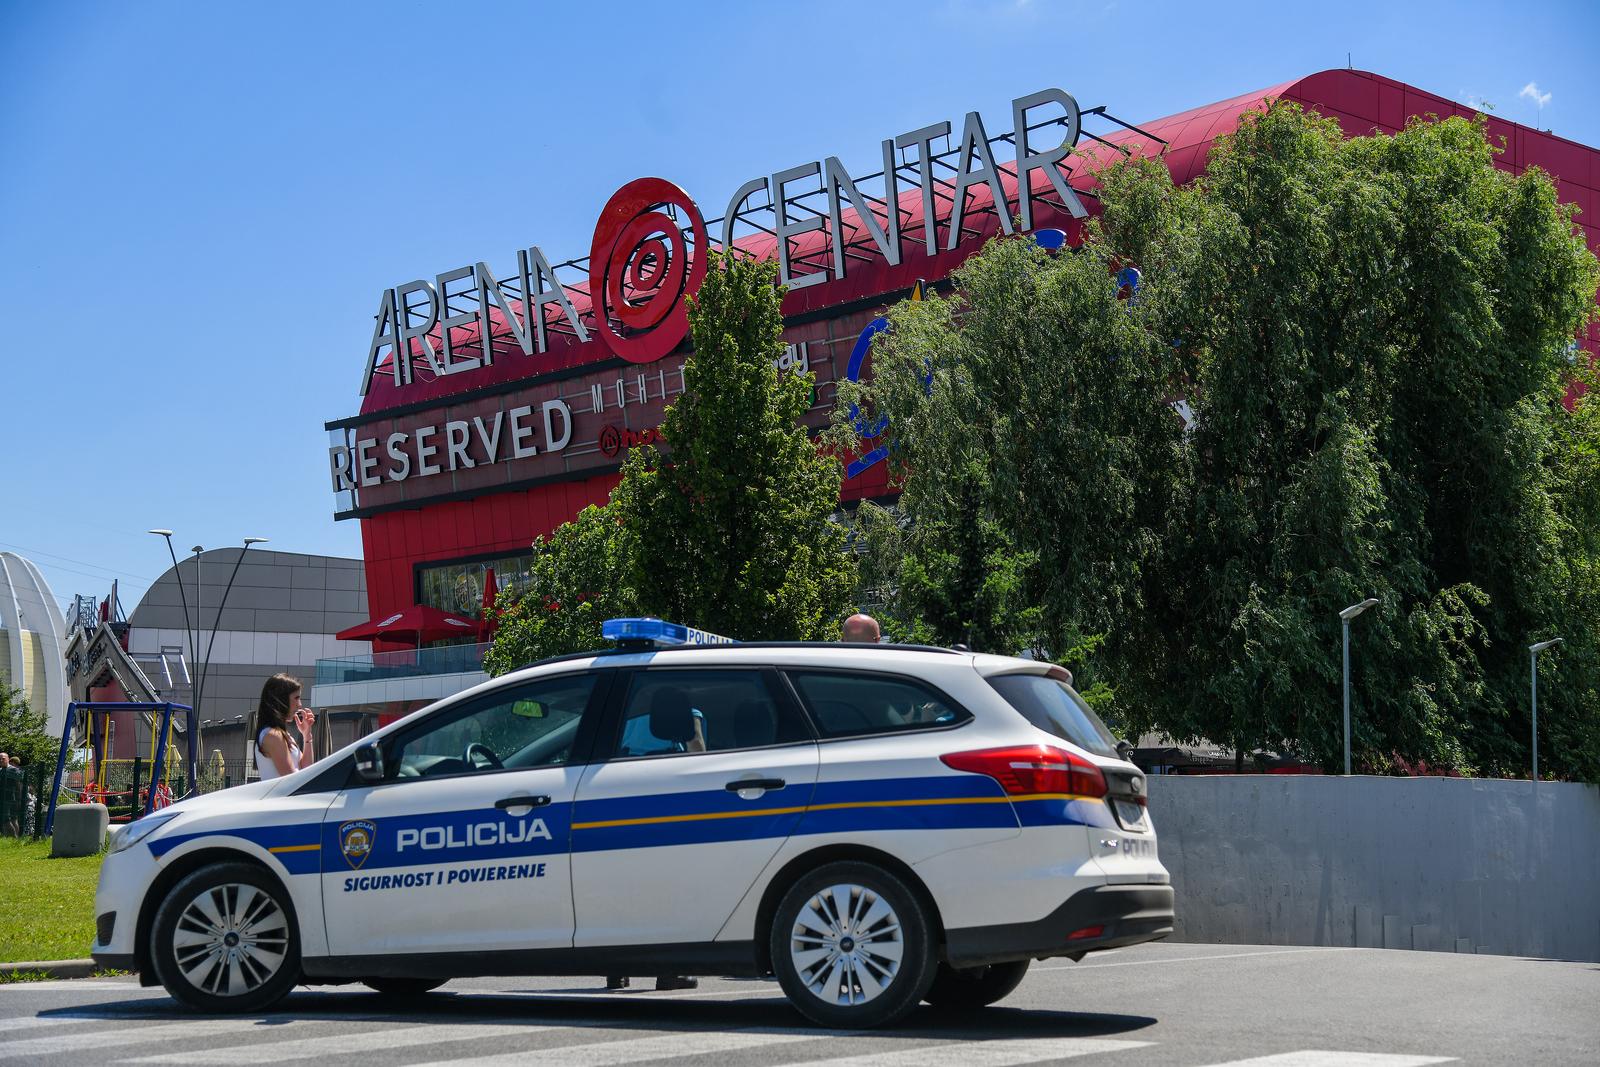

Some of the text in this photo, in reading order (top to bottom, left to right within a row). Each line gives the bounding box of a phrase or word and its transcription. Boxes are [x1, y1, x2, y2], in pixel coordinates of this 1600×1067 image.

[359, 87, 1089, 397] ARENA CENTAR
[591, 364, 687, 414] MOHIT
[328, 399, 574, 493] RESERVED
[342, 821, 374, 833] POLICIJA
[396, 818, 553, 852] POLICIJA
[343, 862, 547, 892] SIGURNOST I POVJERENJE
